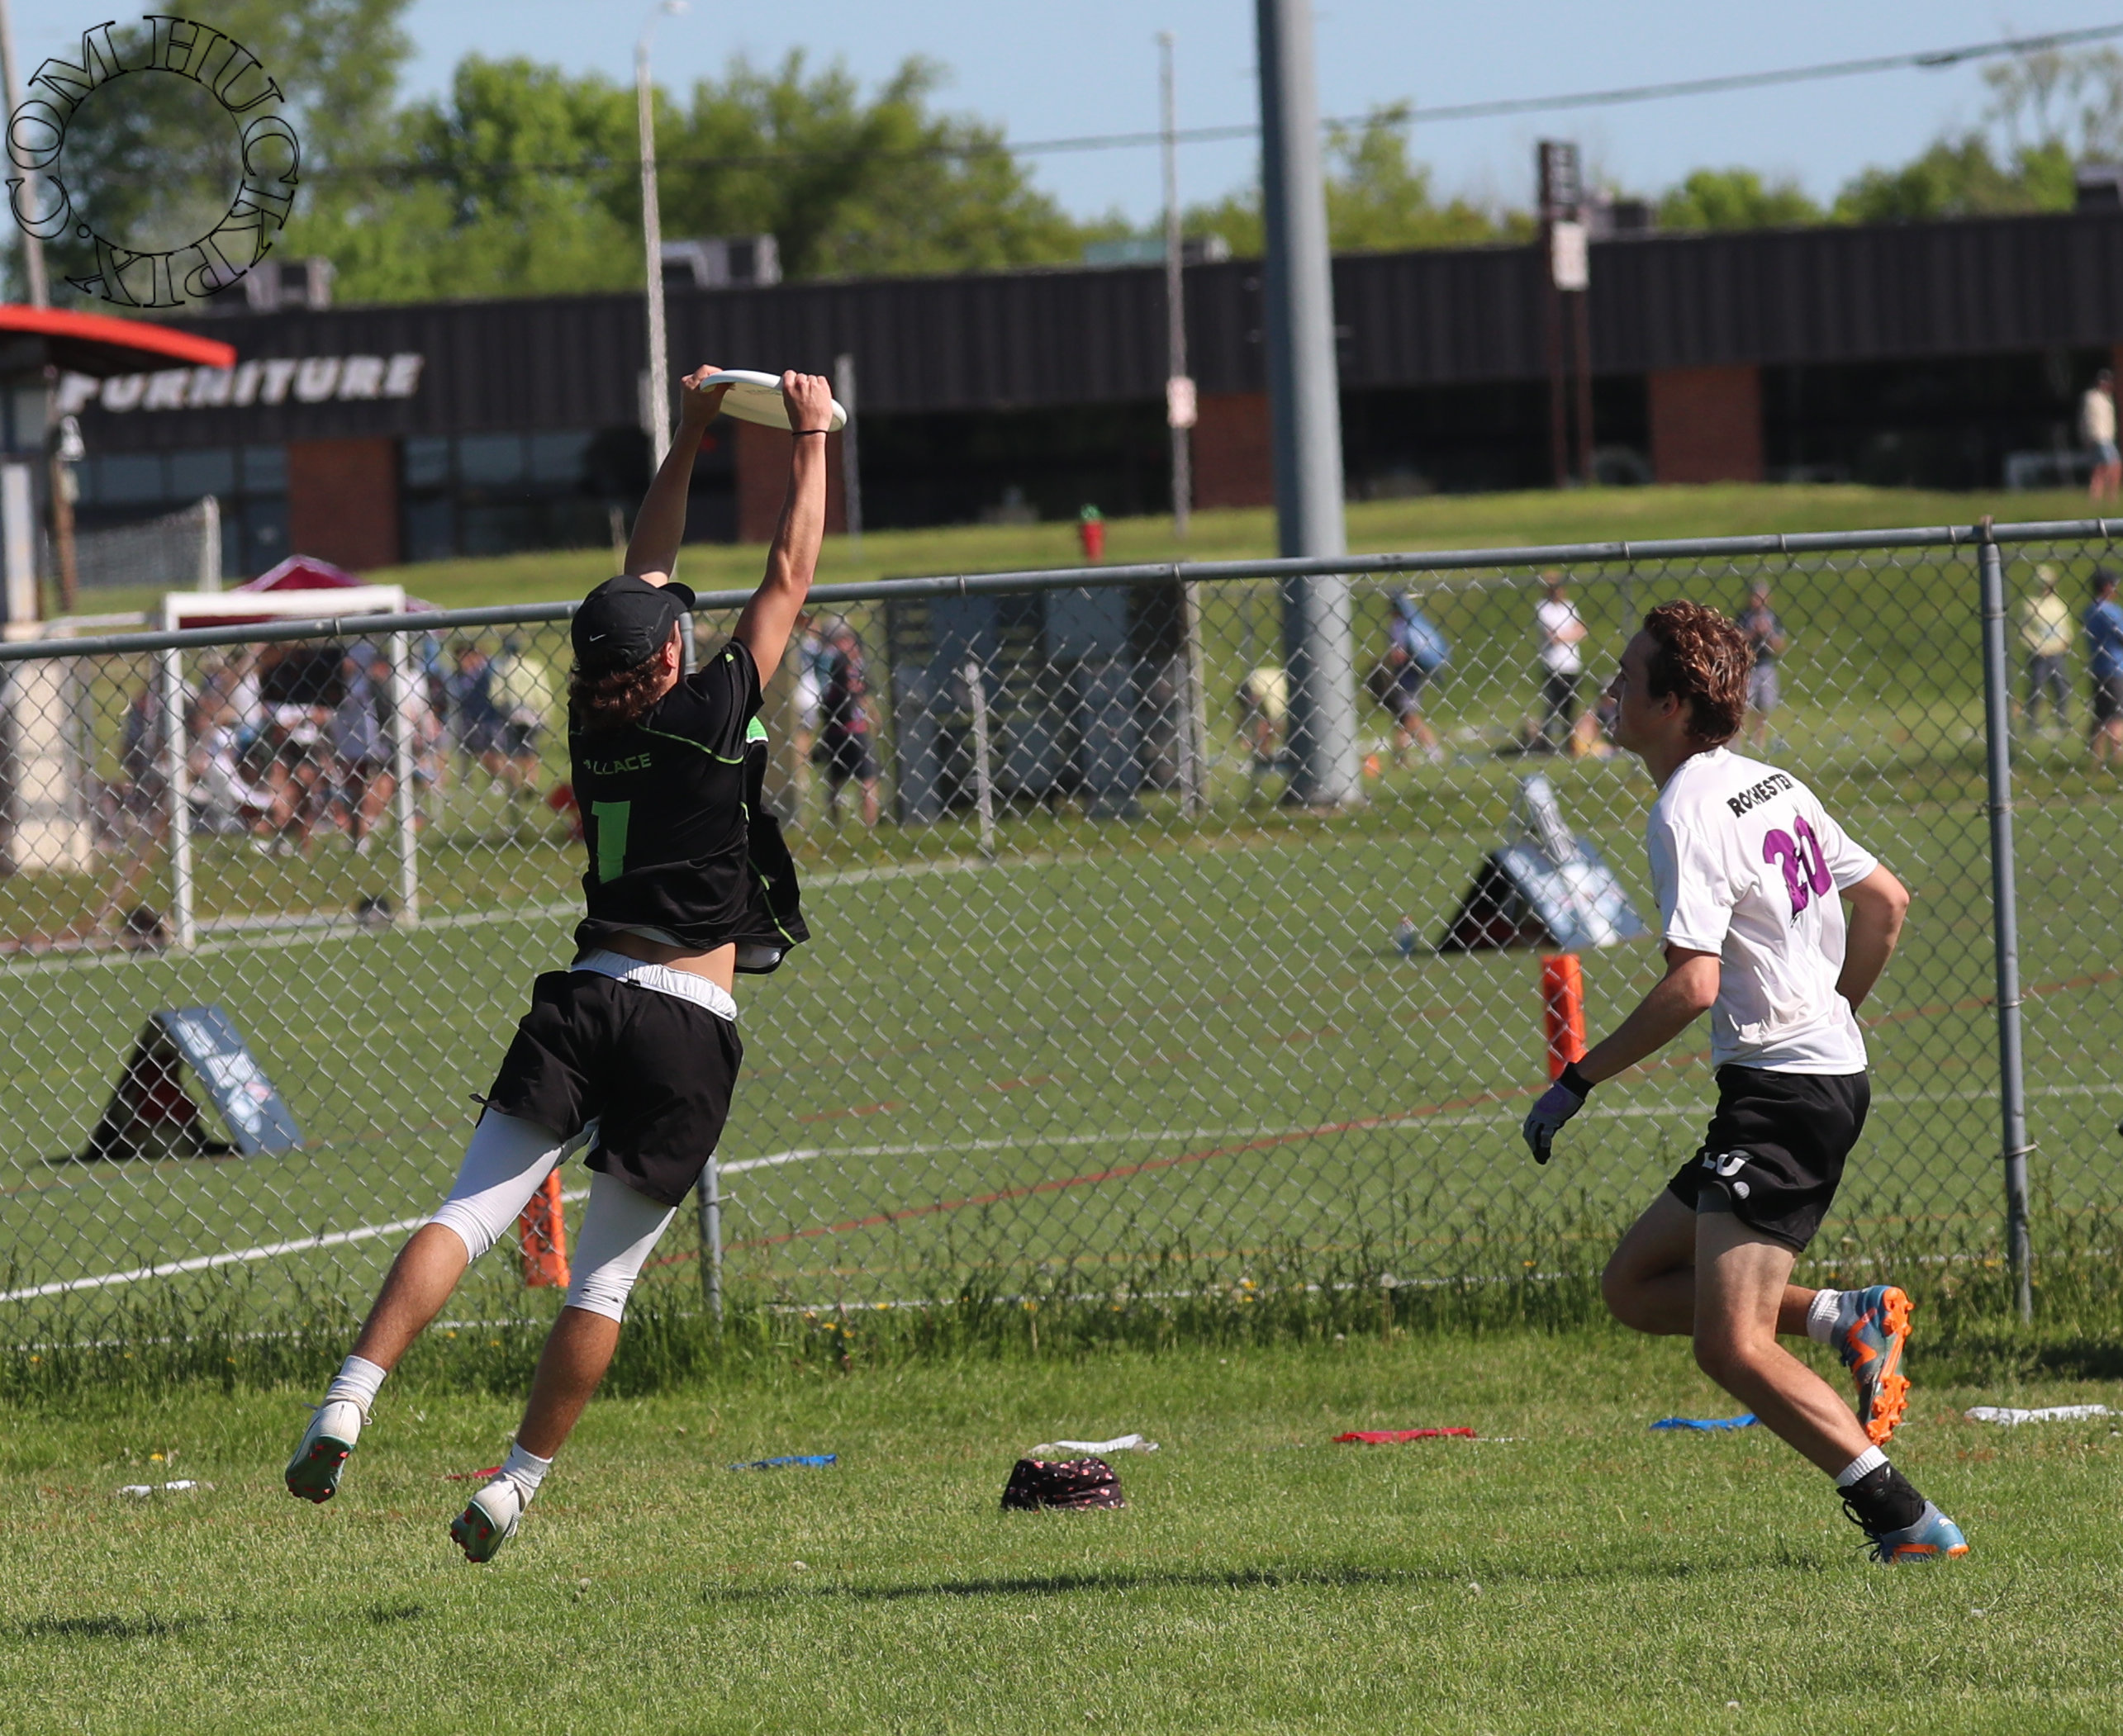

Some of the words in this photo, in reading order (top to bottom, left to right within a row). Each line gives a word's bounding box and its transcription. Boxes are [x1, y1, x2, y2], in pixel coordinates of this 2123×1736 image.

[55, 352, 424, 412] FURNITURE
[591, 799, 631, 885] 1
[1763, 813, 1832, 918] 20
